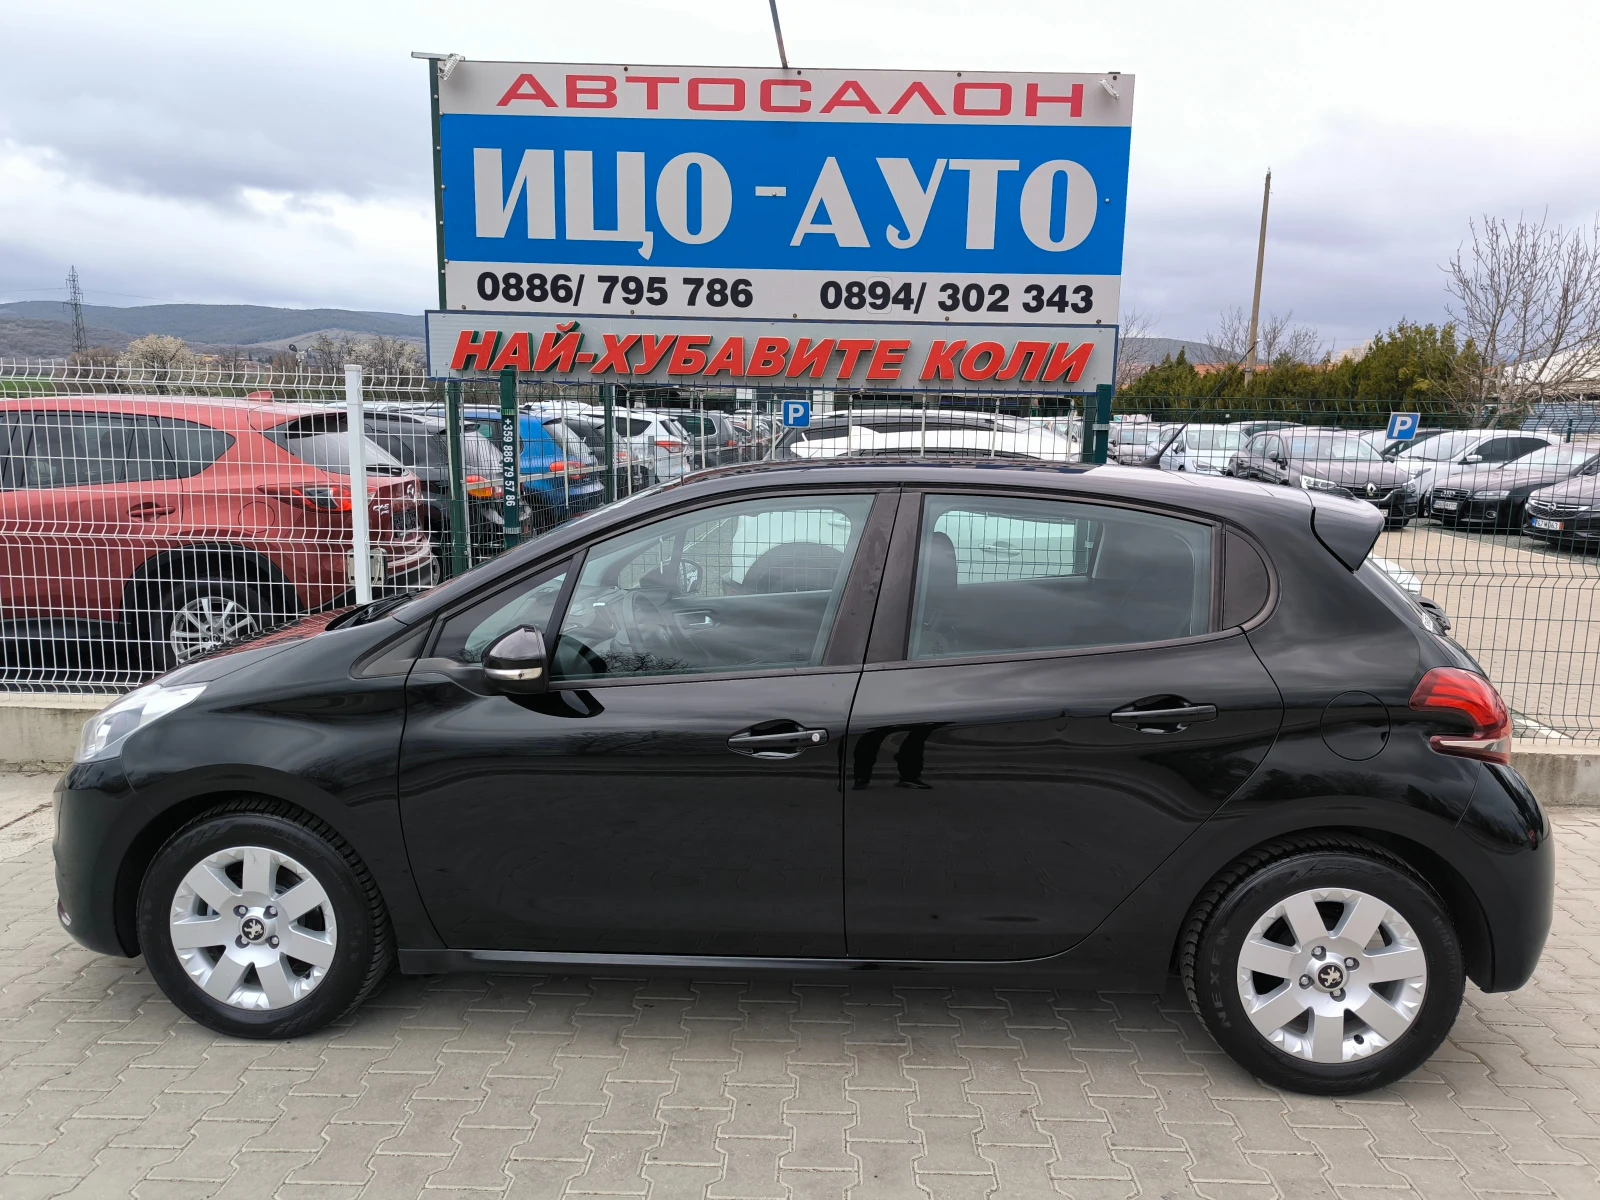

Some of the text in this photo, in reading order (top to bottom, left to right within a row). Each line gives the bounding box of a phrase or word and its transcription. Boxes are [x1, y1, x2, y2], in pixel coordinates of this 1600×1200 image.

[497, 73, 1085, 119] АВТОСАЛОН
[476, 271, 754, 308] 0886/ 795 786
[820, 280, 1094, 315] 0894/ 302 343
[450, 321, 1095, 383] НАЙ-ХУБАВИТЕ КОЛИ
[788, 404, 805, 425] P
[1392, 416, 1413, 437] P
[503, 445, 513, 463] 886
[503, 466, 514, 477] 79
[504, 480, 515, 492] 57
[505, 495, 516, 506] 86
[1210, 927, 1232, 1028] NEXEN
